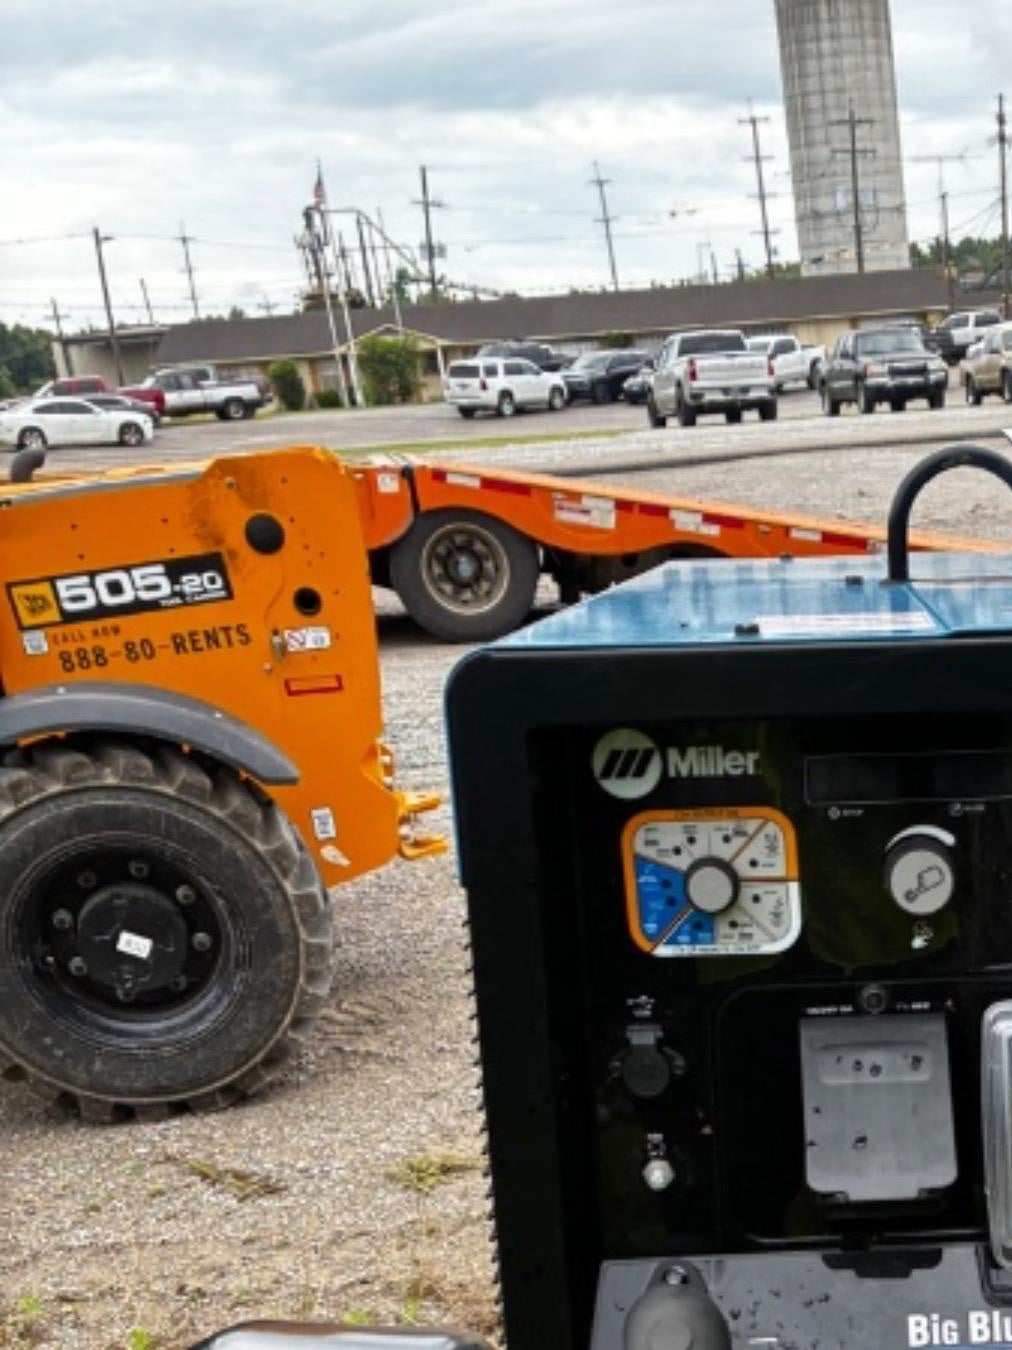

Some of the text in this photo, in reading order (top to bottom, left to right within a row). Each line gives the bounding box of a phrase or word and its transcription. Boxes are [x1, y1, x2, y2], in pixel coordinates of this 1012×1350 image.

[56, 562, 223, 613] 505-20
[58, 623, 252, 674] 888-80-RENTS
[667, 746, 760, 778] Miller
